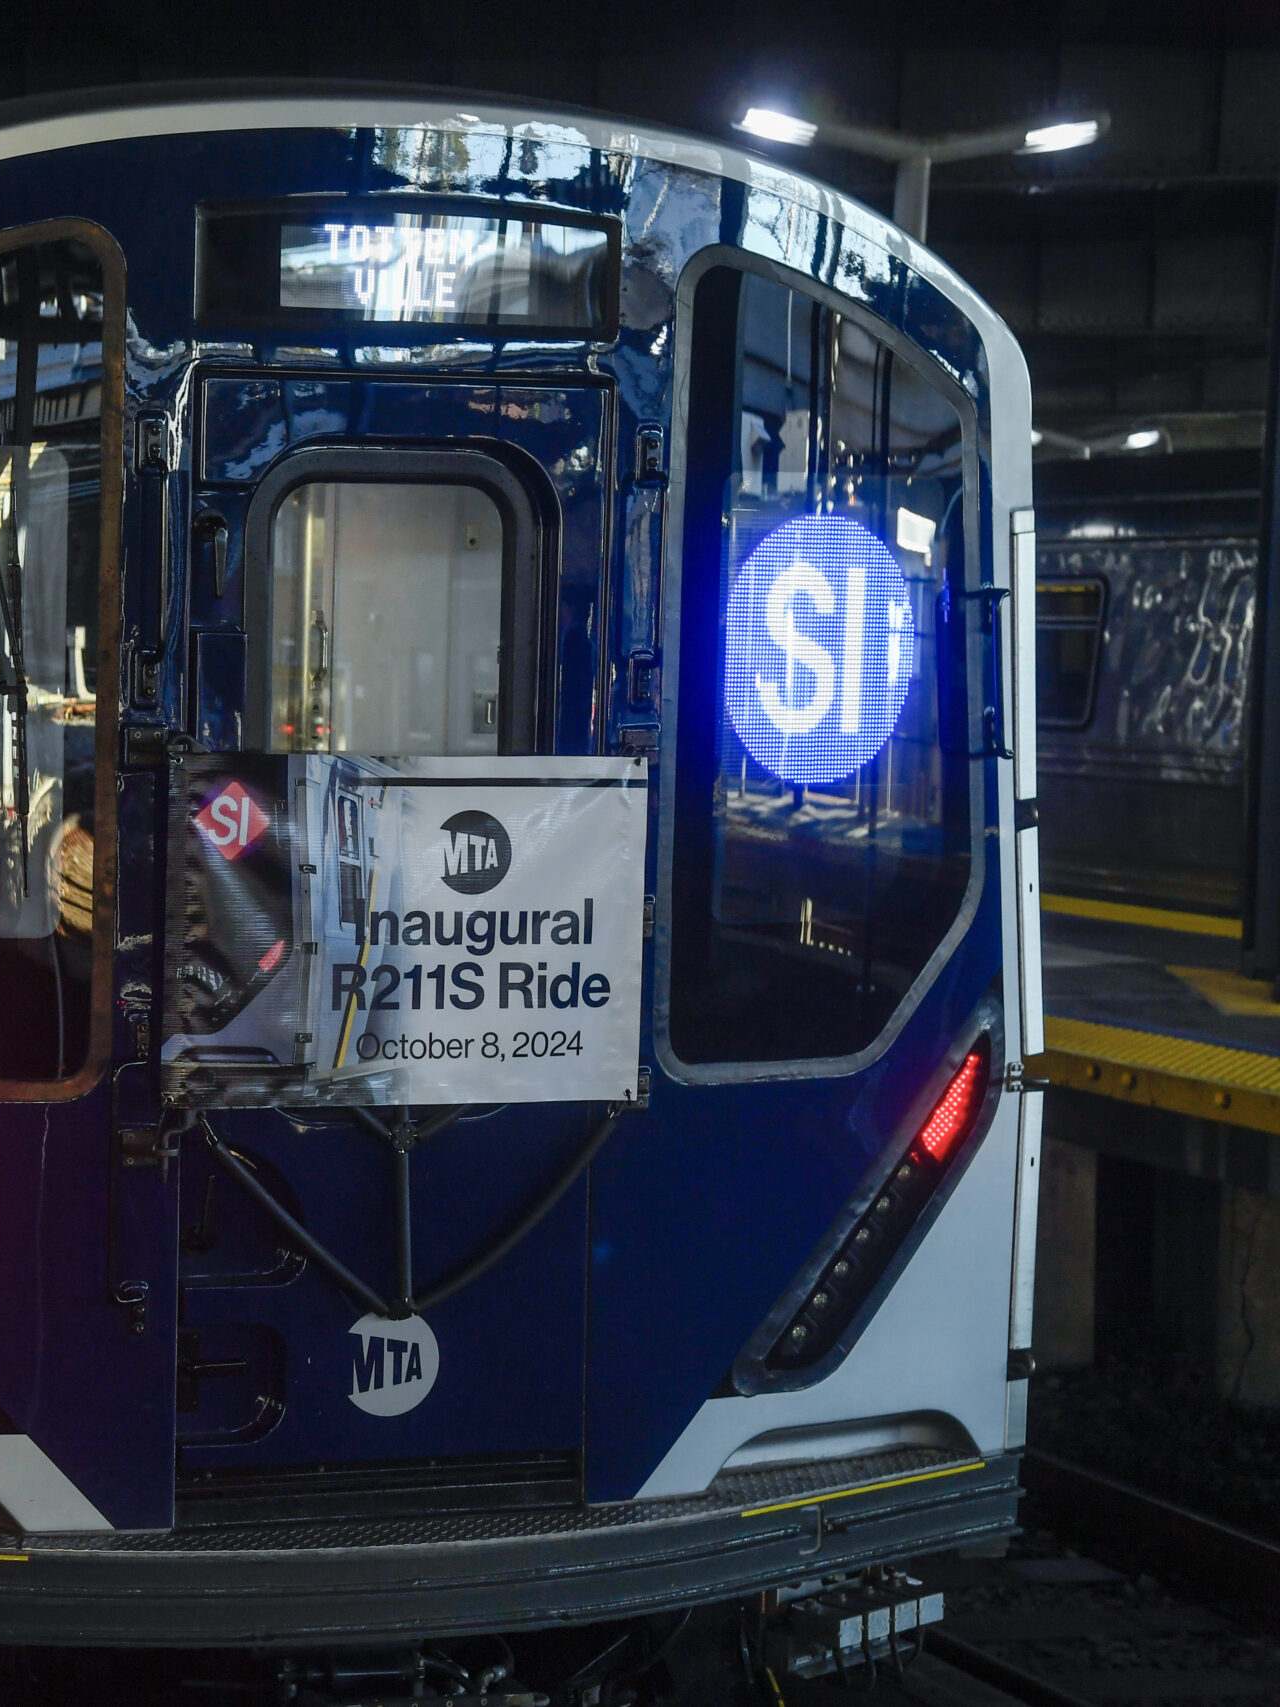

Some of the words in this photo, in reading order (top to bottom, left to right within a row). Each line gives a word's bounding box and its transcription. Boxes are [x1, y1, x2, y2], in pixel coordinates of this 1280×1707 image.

[756, 562, 866, 733] SI
[208, 795, 250, 846] SI
[440, 828, 499, 878] MTA
[355, 898, 594, 956] Inaugural
[332, 962, 485, 1010] R211S
[499, 962, 611, 1009] Ride
[356, 1032, 475, 1060] October
[481, 1032, 506, 1062] 8,
[512, 1030, 583, 1058] 2024
[349, 1331, 422, 1395] MTA
